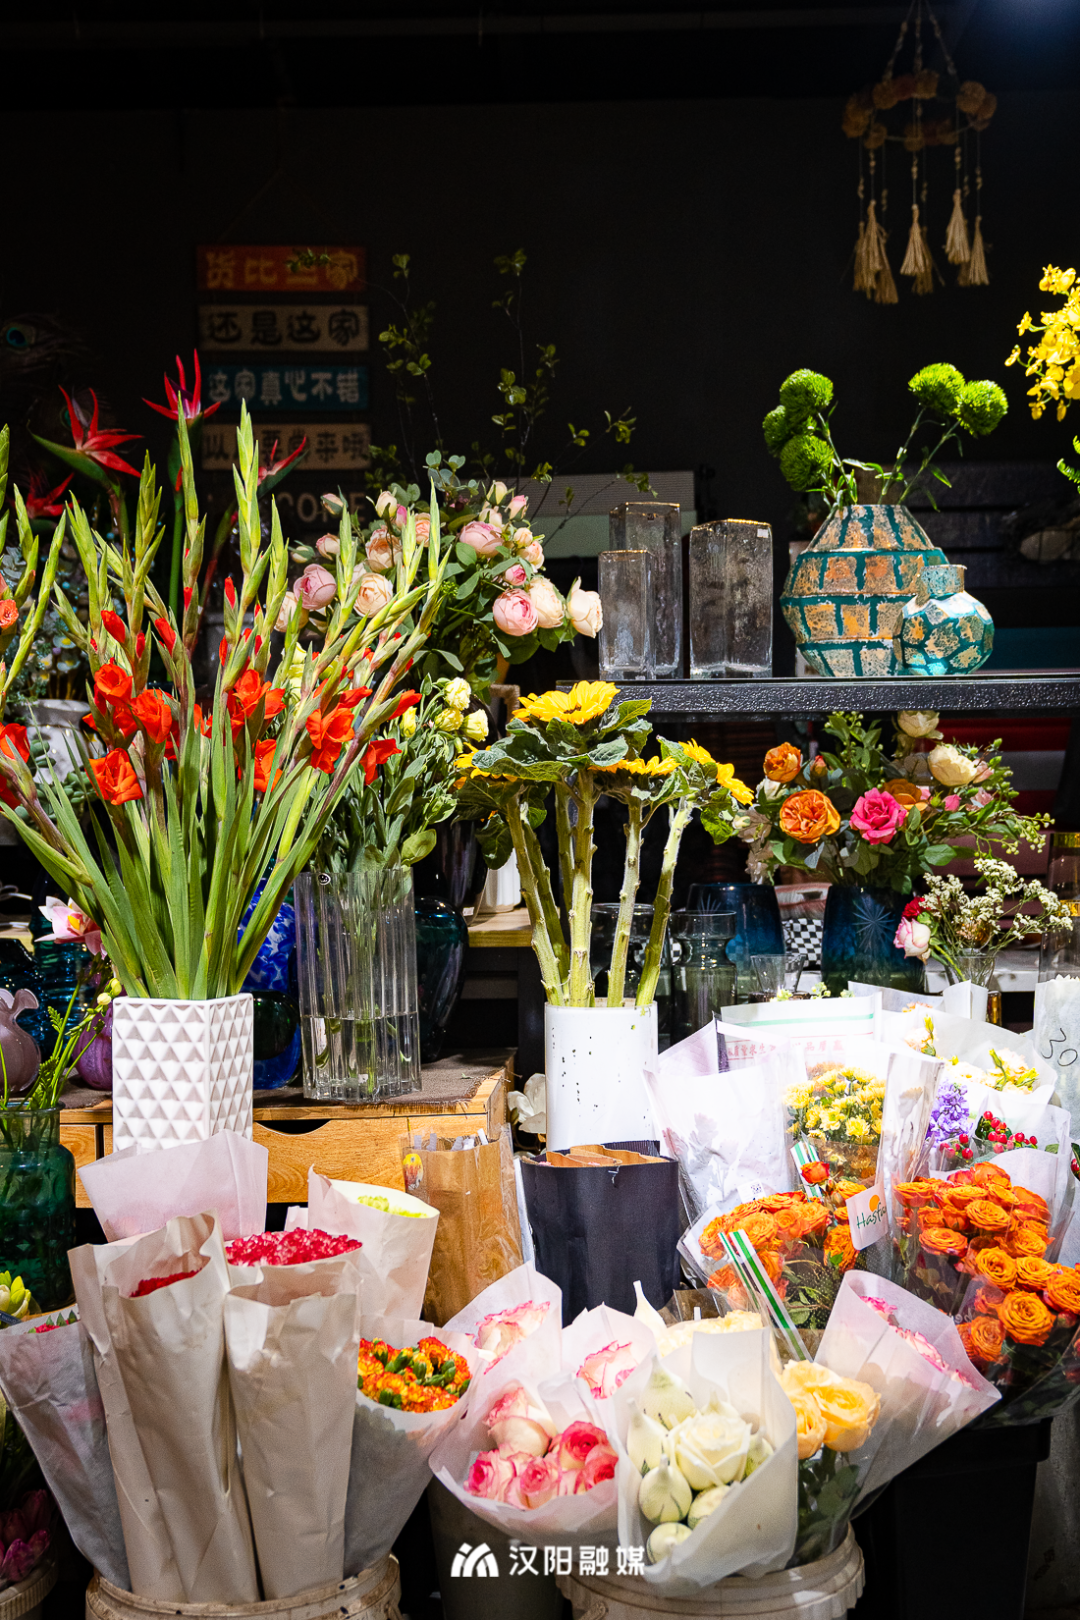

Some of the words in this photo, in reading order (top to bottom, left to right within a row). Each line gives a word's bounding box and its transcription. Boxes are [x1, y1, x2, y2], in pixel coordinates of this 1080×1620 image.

[207, 309, 360, 346] 还是这家
[208, 369, 360, 406] 这家真心不错
[204, 428, 366, 462] 以要常来哦
[1040, 1027, 1078, 1067] 30
